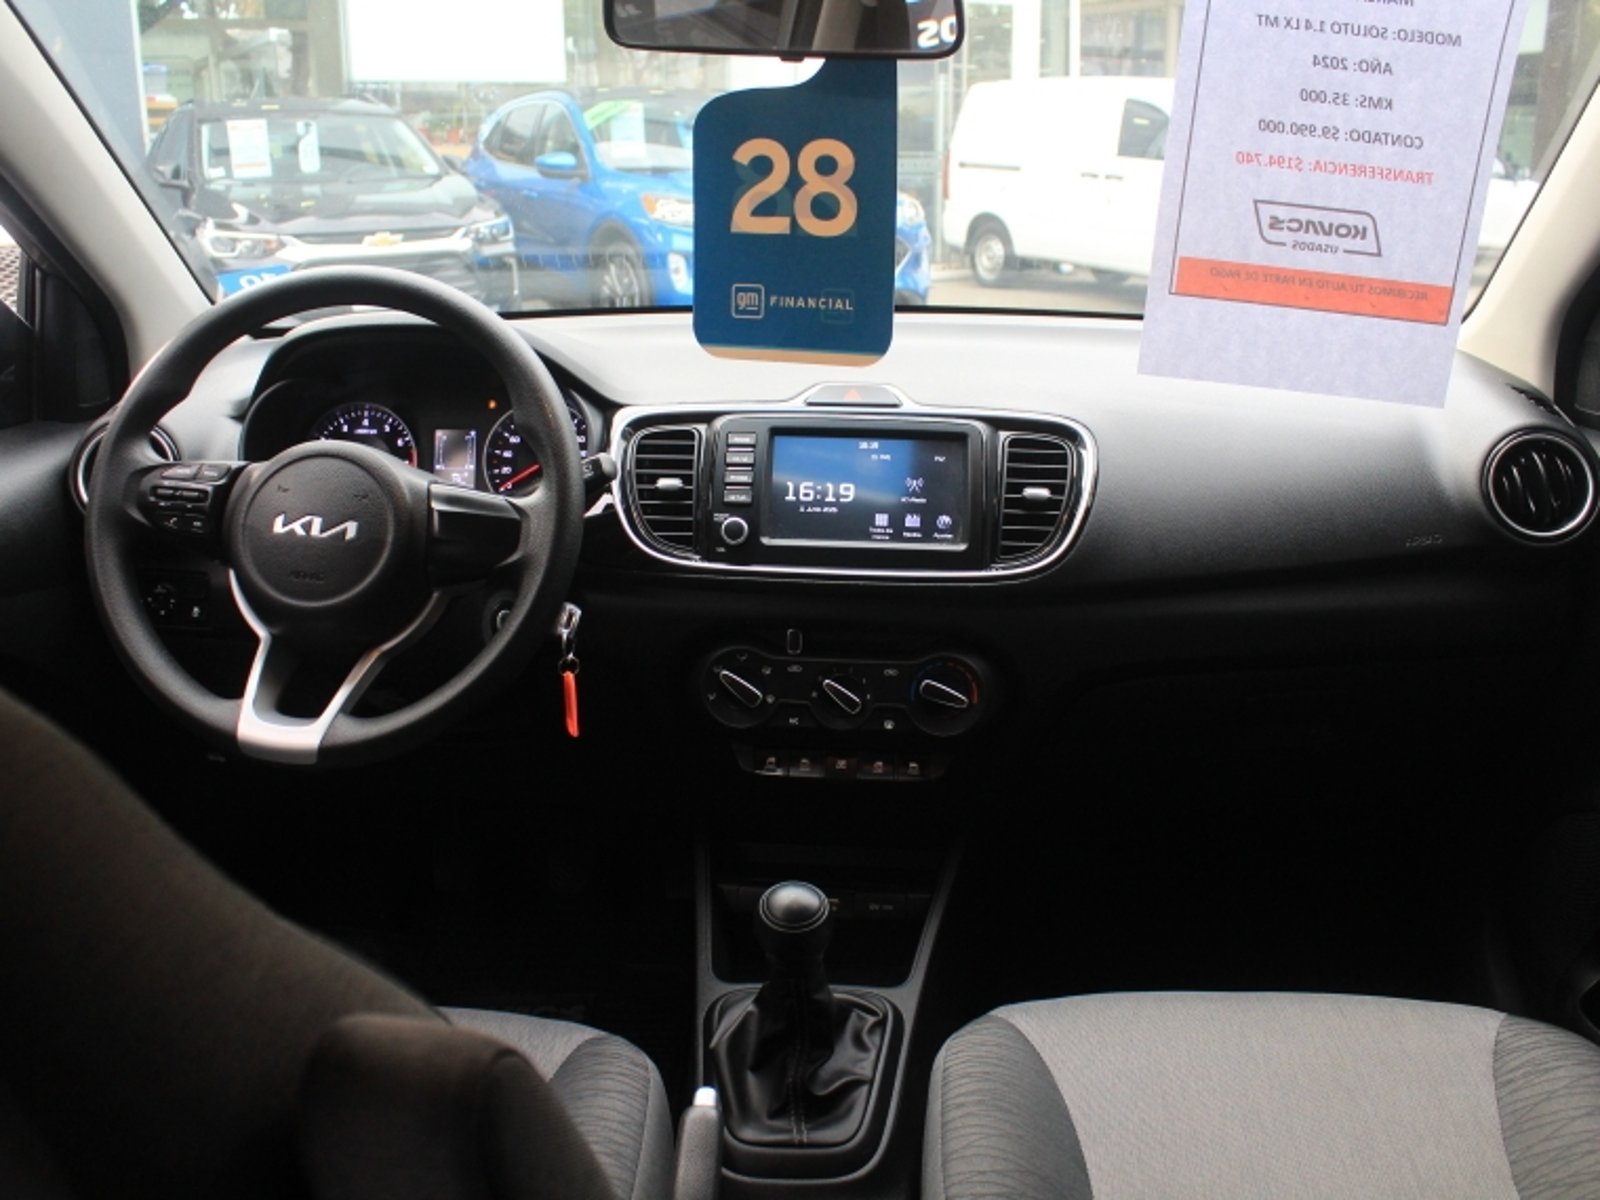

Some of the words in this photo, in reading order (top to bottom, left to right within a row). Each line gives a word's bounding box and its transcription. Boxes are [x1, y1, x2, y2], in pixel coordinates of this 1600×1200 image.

[730, 138, 858, 237] 28
[769, 294, 854, 311] FINANCIAL
[785, 481, 856, 502] 16:19
